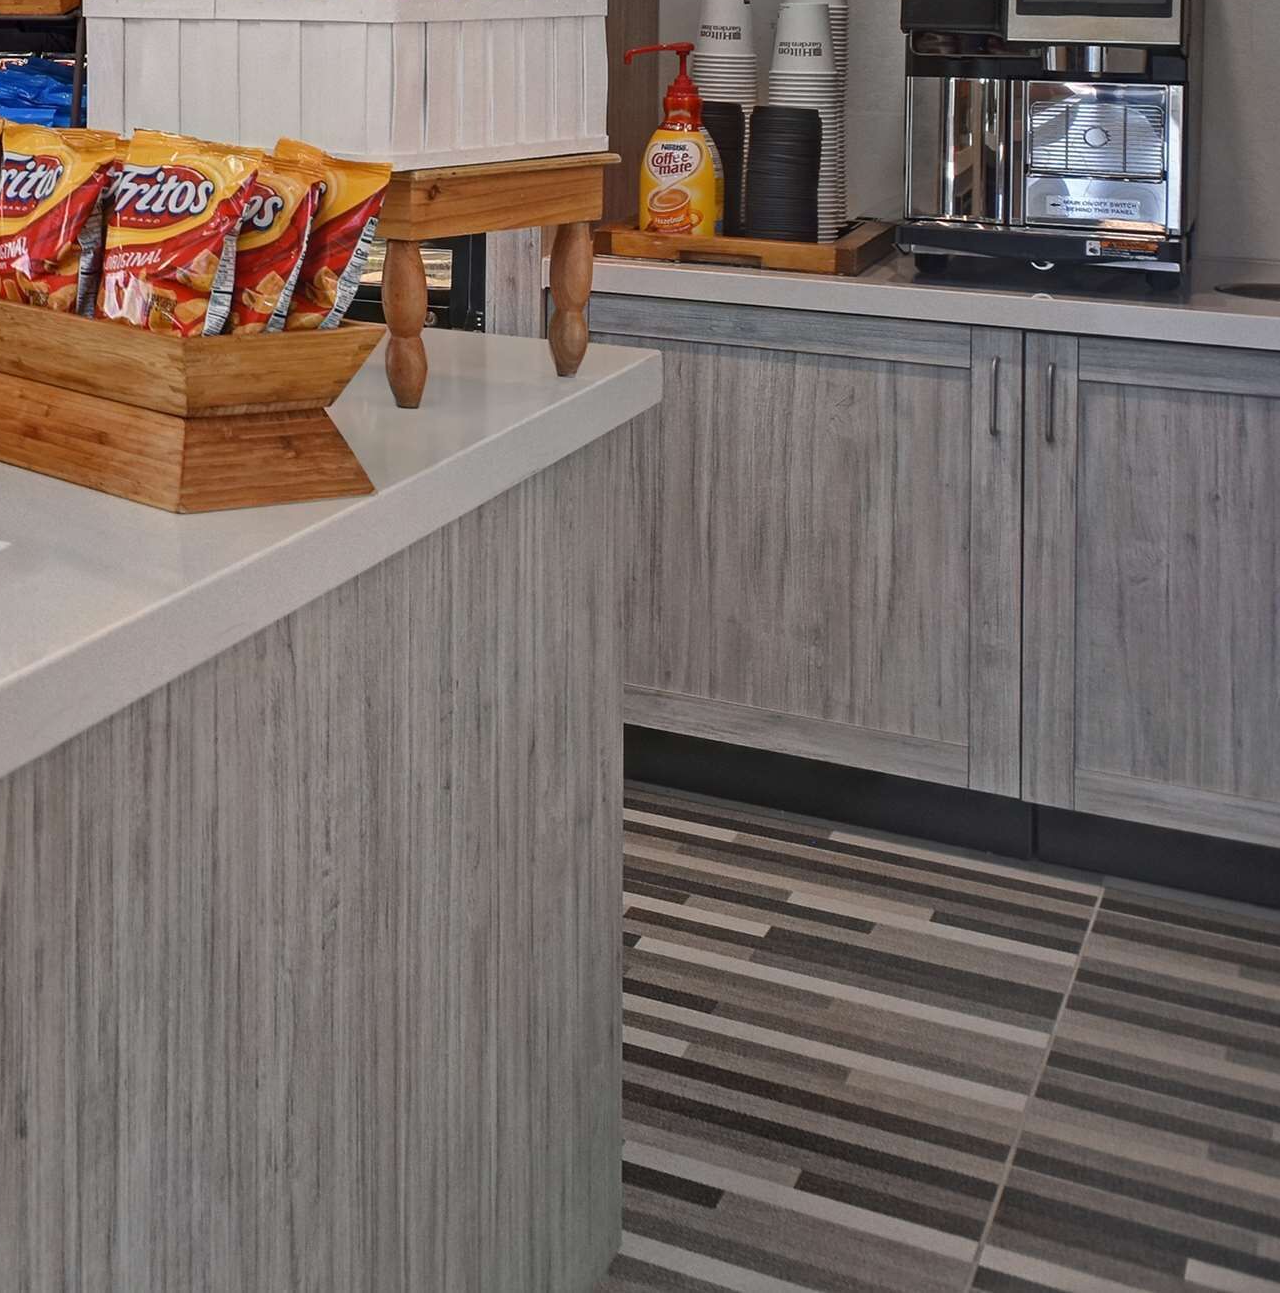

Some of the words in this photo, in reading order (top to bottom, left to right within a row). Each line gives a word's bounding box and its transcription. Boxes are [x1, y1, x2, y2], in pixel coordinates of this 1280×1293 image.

[700, 31, 732, 40] Hilton
[777, 48, 813, 57] Hilton
[658, 162, 693, 175] mate
[114, 164, 215, 215] Fritos
[105, 248, 162, 270] ORIGINAL
